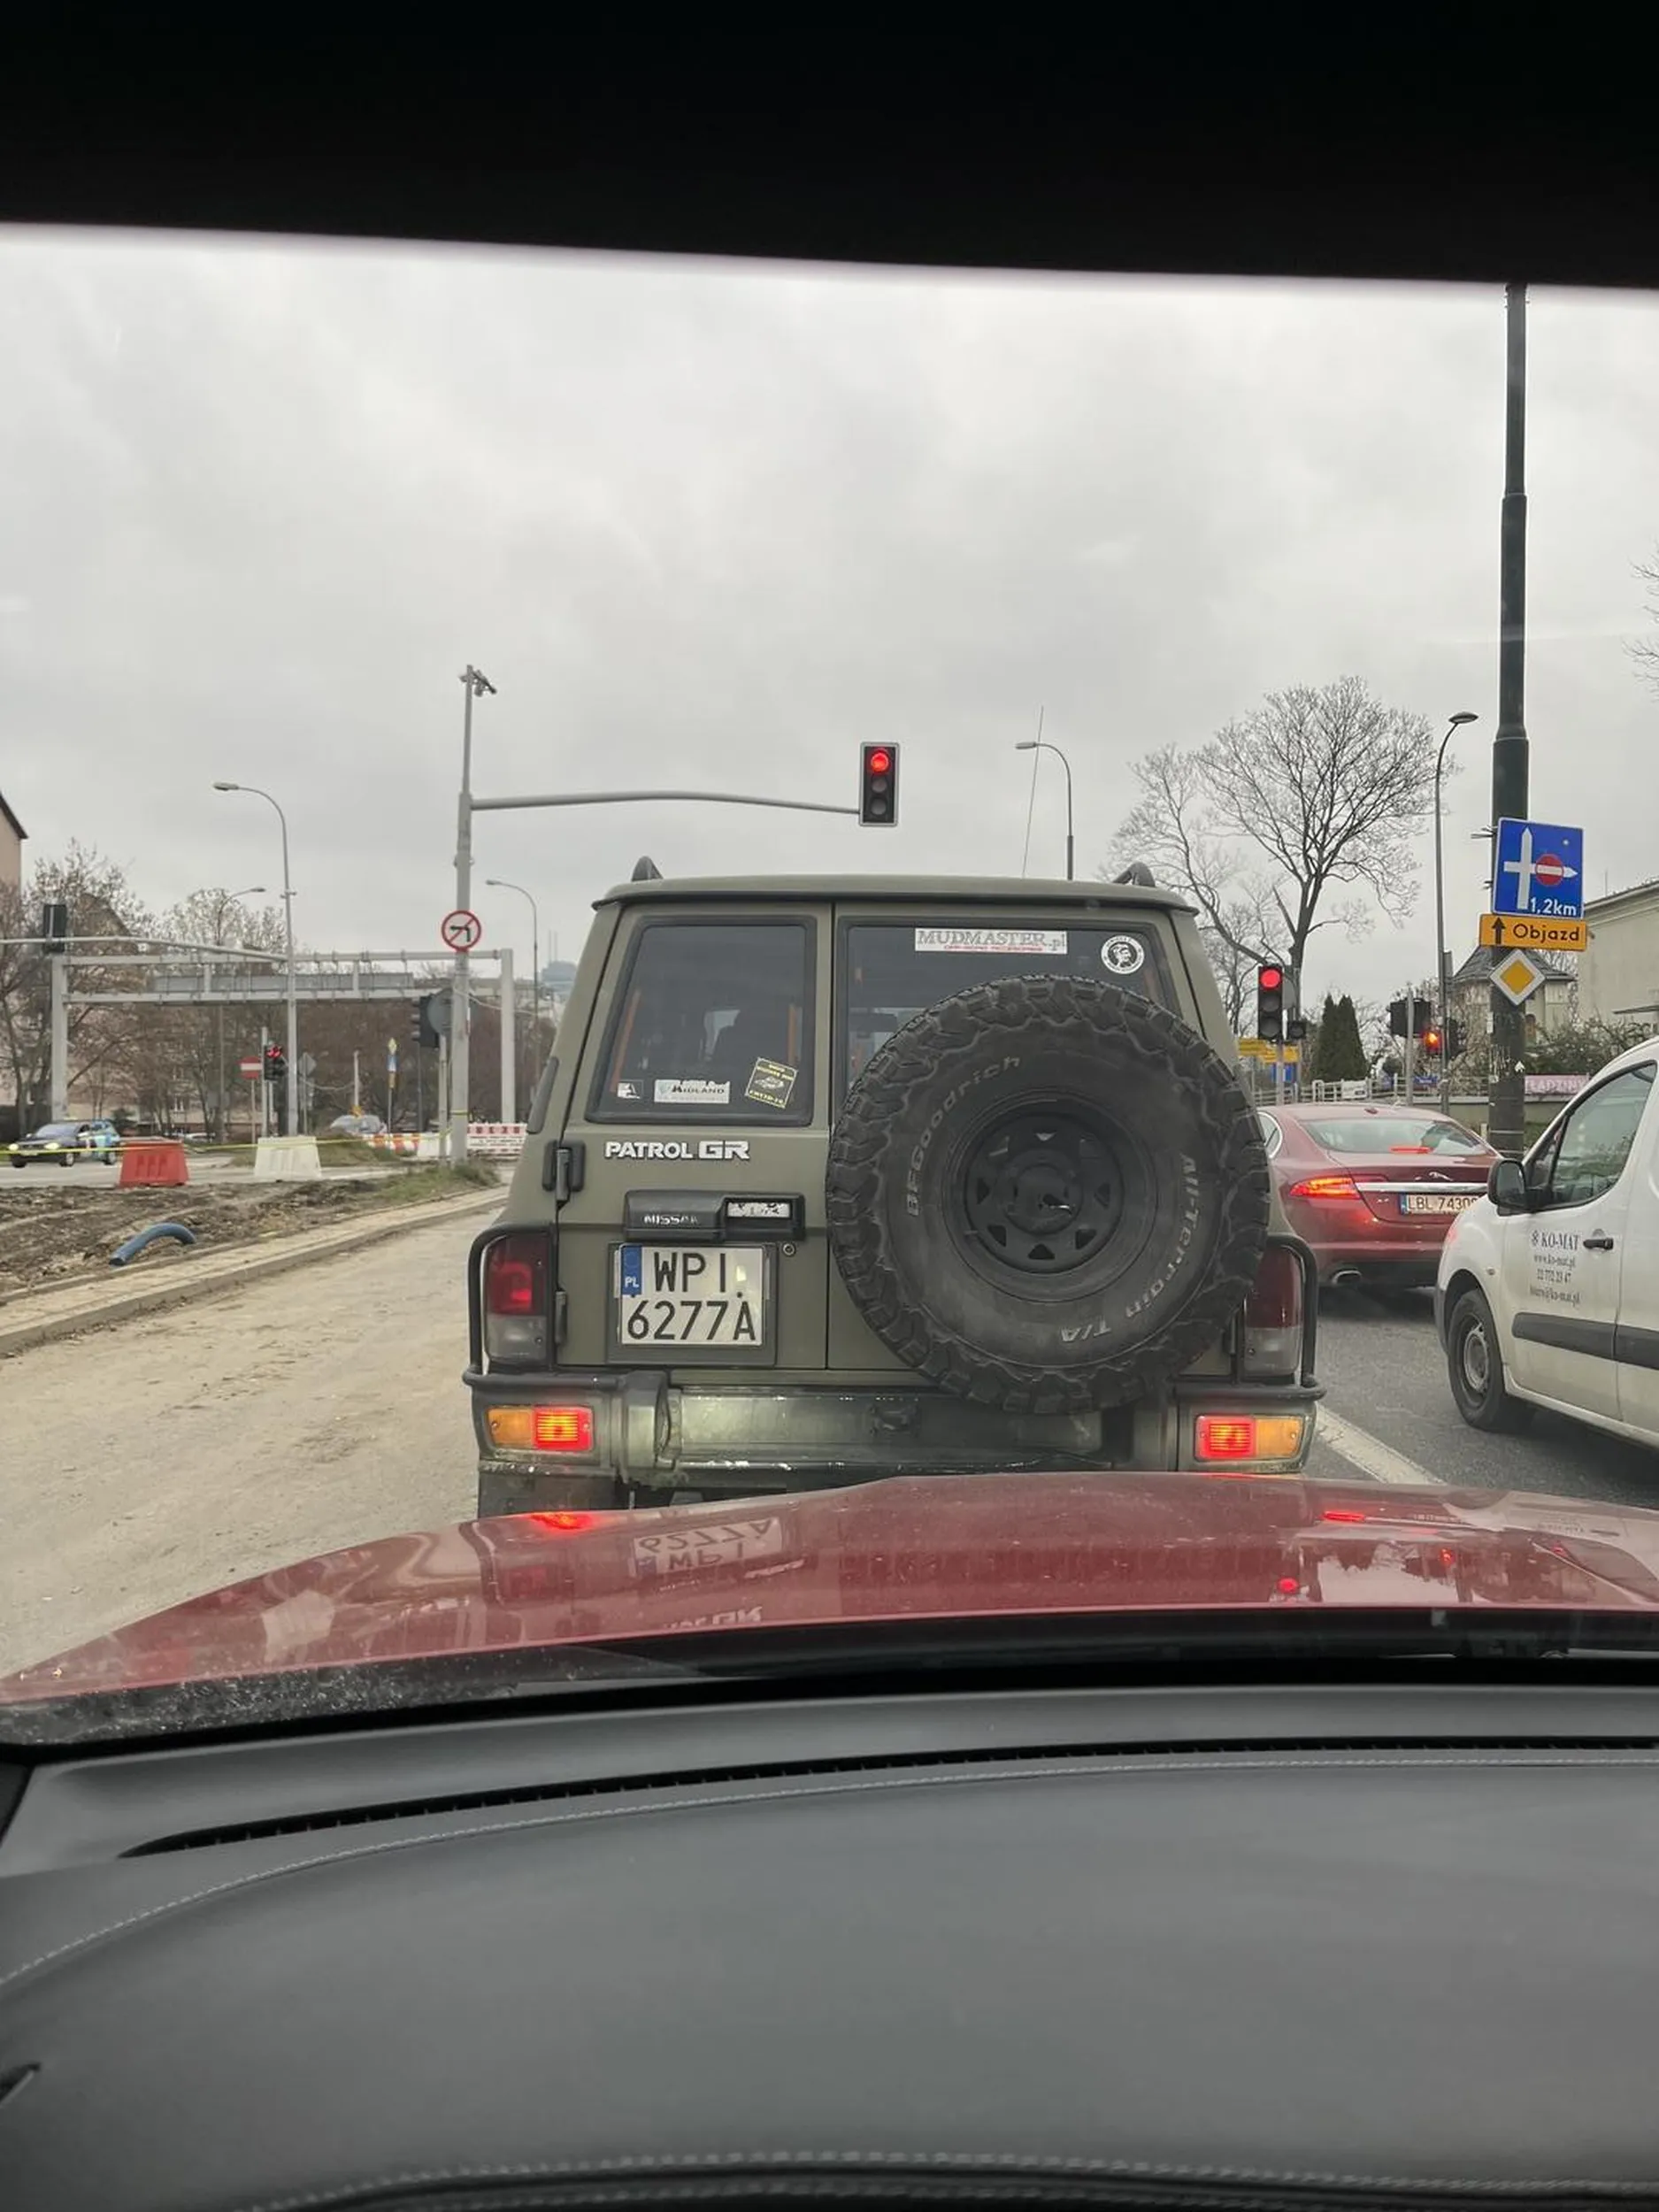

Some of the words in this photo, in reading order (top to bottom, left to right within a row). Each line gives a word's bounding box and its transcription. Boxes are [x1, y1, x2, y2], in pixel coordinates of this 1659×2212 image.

[1531, 897, 1577, 917] 1,2km
[1513, 923, 1580, 944] Objazd
[907, 1056, 1020, 1217] BFGoodrich
[605, 1141, 693, 1159] PATROL
[698, 1140, 750, 1160] GR
[1408, 1196, 1433, 1210] LBL
[1541, 1232, 1578, 1250] KO-MAT
[624, 1276, 640, 1288] PL
[653, 1251, 726, 1293] WPI
[626, 1300, 757, 1341] 6277A
[1061, 1319, 1111, 1342] T/A
